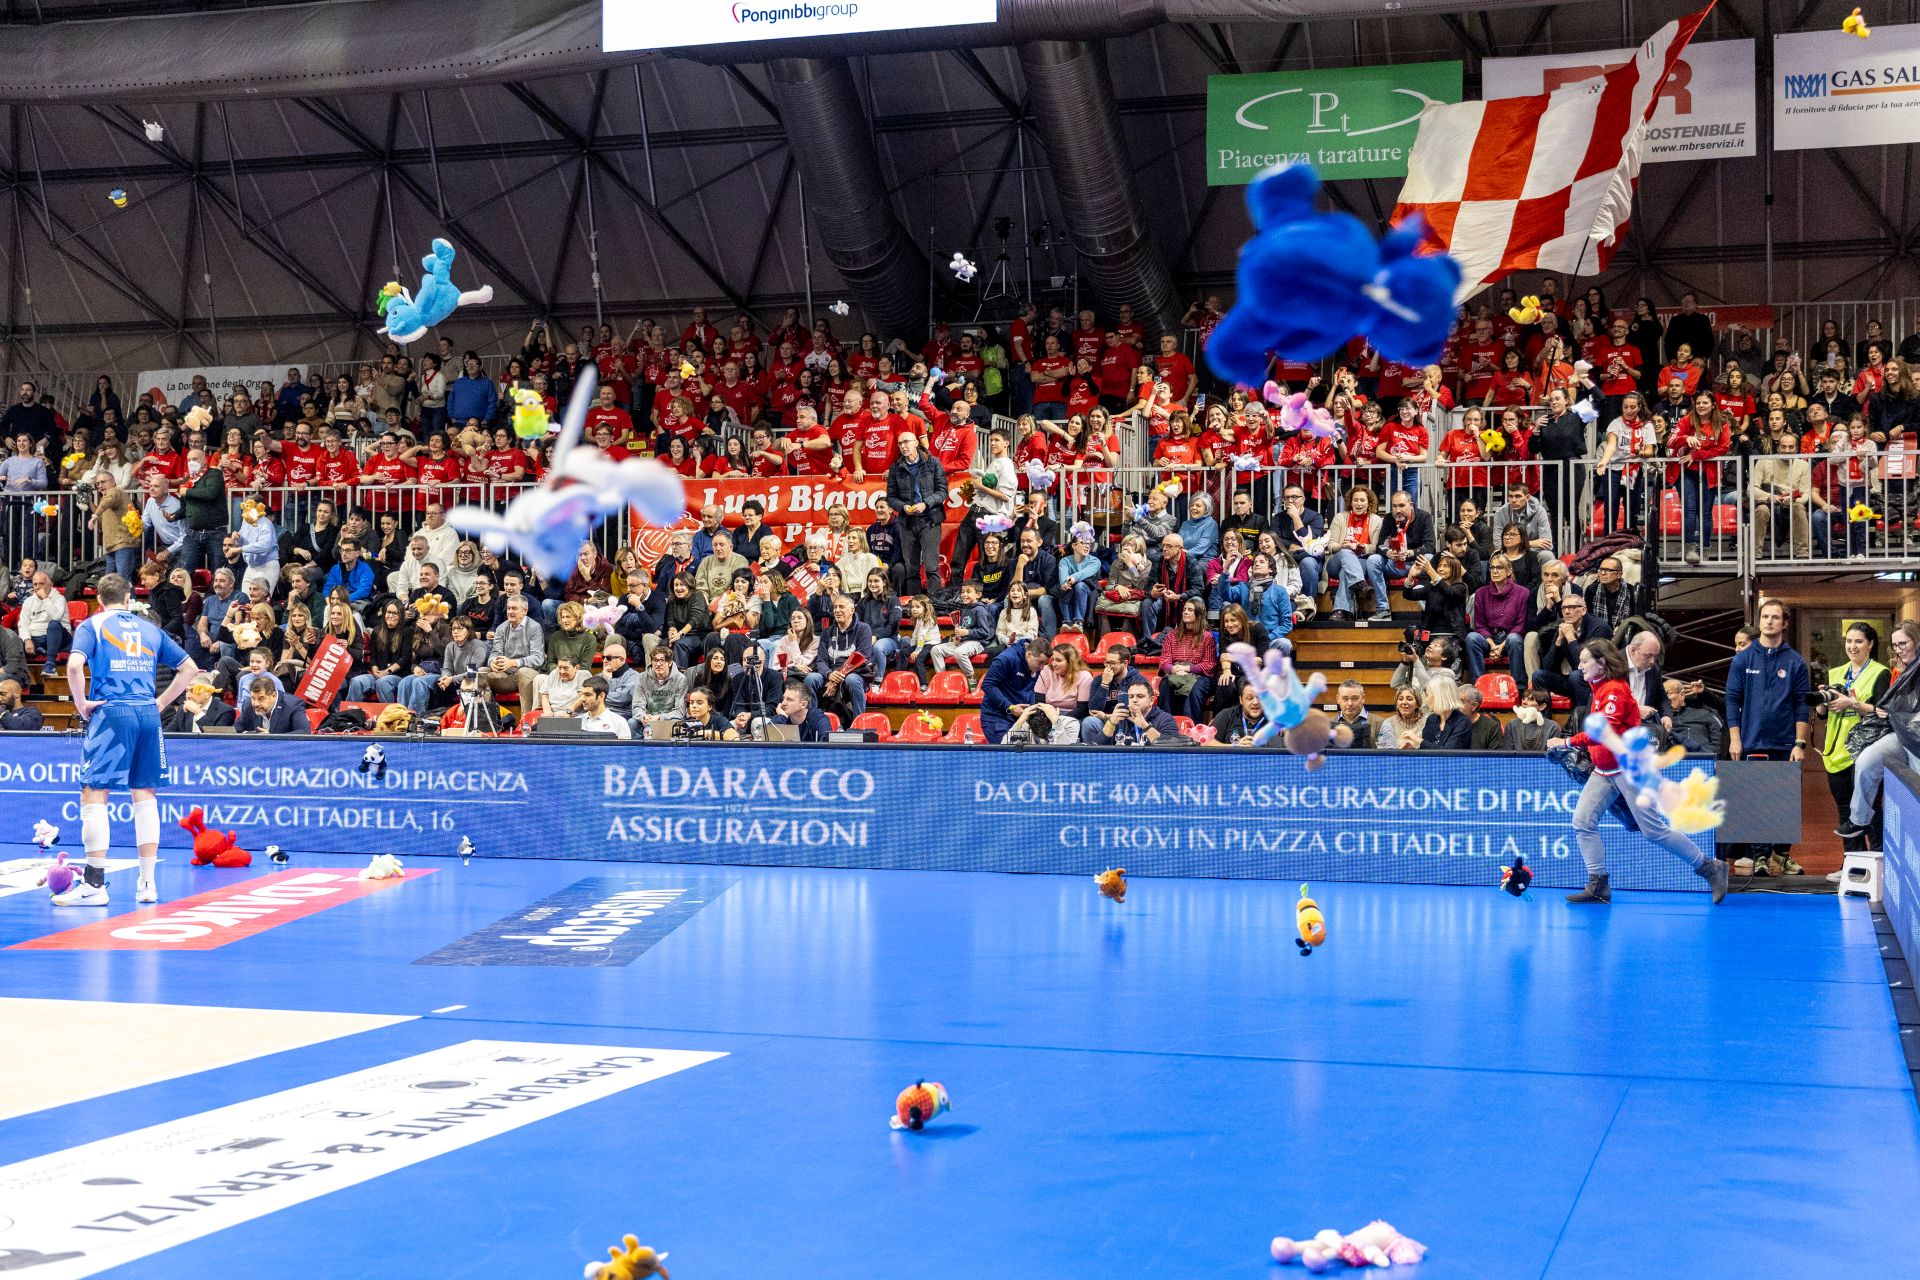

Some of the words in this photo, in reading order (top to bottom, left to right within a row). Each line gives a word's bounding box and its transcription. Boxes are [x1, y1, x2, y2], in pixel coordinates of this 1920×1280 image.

[742, 3, 858, 24] Ponginibbigroup
[1831, 68, 1876, 88] GAS
[1793, 105, 1827, 114] fornitore
[1829, 104, 1837, 112] di
[1838, 103, 1864, 112] fiducia
[1865, 103, 1880, 111] per
[1644, 122, 1747, 141] SOSTENIBILE
[1651, 138, 1745, 153] www.mbrservizi.it
[1218, 149, 1311, 169] Piacenza
[1318, 147, 1402, 165] tarature
[167, 382, 176, 391] La
[123, 632, 141, 657] 27
[303, 643, 345, 702] MURATO
[30, 763, 80, 783] OLTR
[385, 769, 408, 790] DI
[413, 770, 528, 793] PIACENZA
[604, 764, 875, 801] BADARACCO
[975, 780, 1011, 802] DA
[1017, 780, 1101, 804] OLTRE
[1109, 782, 1139, 805] 40
[1143, 783, 1209, 806] ANNI
[1217, 784, 1471, 811] L'ASSICURAZIONE
[1477, 789, 1508, 812] DI
[1516, 789, 1581, 813] PIAC
[161, 803, 183, 823] IN
[190, 804, 269, 826] IAZZA
[274, 805, 424, 833] CITTADELLA,
[431, 811, 455, 832] 16
[606, 815, 869, 847] ASSICURAZIONI
[1059, 825, 1088, 847] CI
[1099, 825, 1179, 849] TROVI
[1188, 828, 1216, 850] IN
[1224, 828, 1327, 853] PIAZZA
[1334, 830, 1528, 859] CITTADELLA,
[1538, 832, 1570, 859] 16
[366, 1056, 656, 1139] CARBURANTE
[310, 1143, 386, 1155] &
[71, 1160, 335, 1233] SERVIZI
